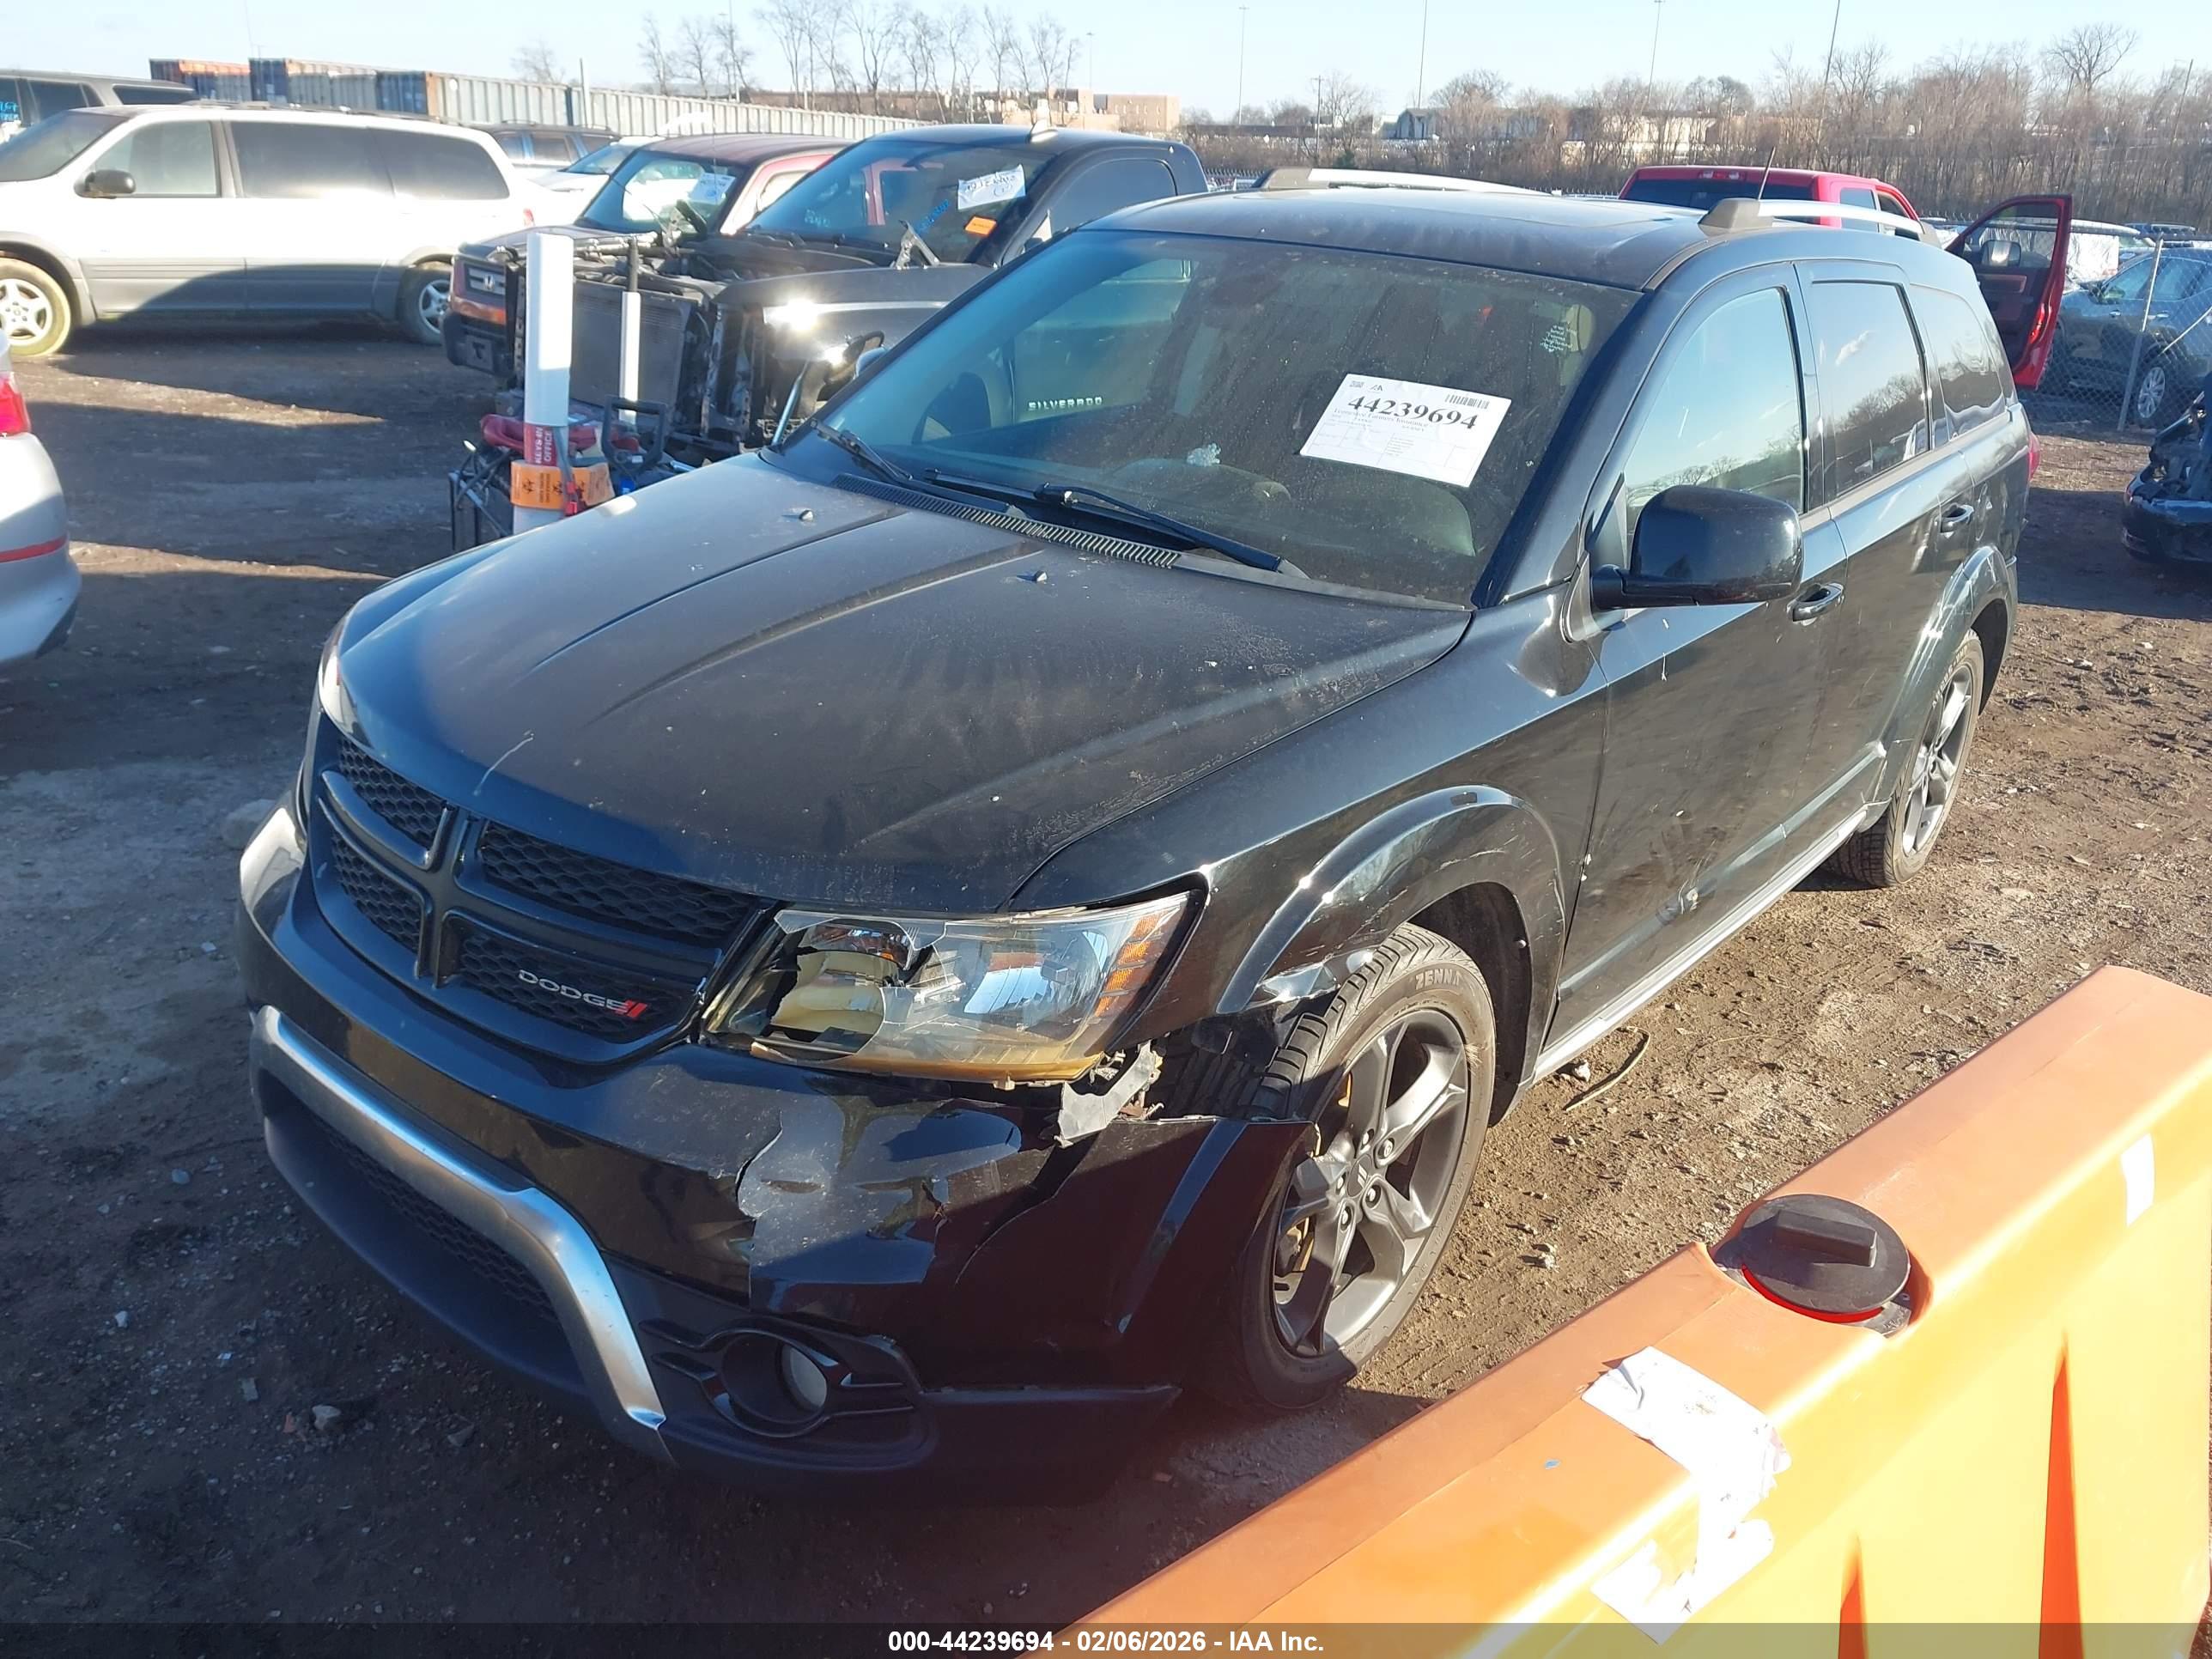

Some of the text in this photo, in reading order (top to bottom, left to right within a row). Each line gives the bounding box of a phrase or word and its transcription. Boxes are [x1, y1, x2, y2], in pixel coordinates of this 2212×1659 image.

[1028, 396, 1103, 411] SILVERADO
[1348, 395, 1479, 429] 44239694
[534, 427, 544, 464] KEYS IN
[544, 430, 552, 461] OFFICE
[518, 969, 629, 1013] DODGE
